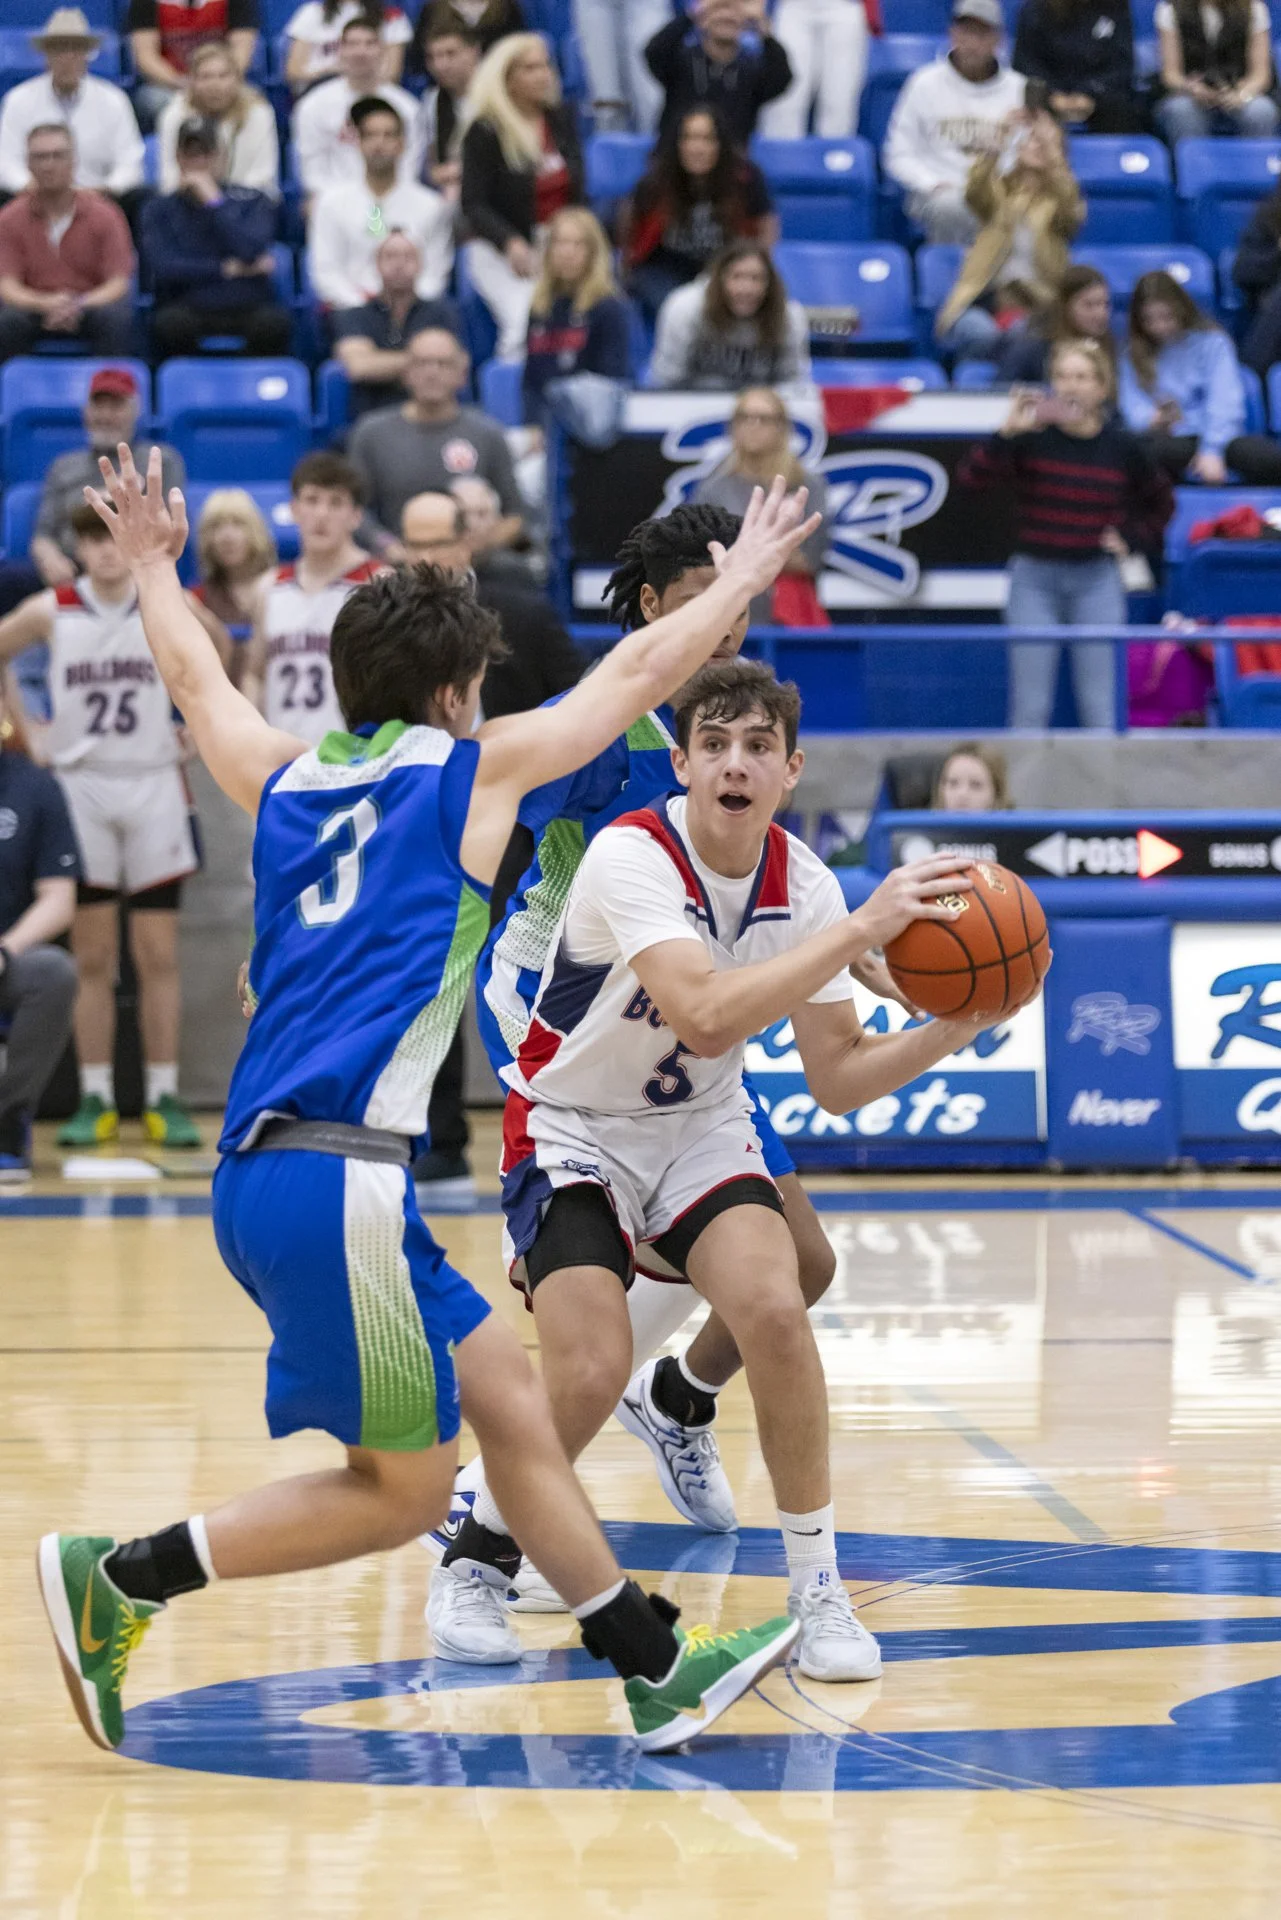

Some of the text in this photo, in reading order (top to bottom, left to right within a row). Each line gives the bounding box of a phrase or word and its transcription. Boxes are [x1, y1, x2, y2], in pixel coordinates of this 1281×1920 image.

[279, 662, 325, 711] 23
[85, 691, 138, 736] 25
[295, 794, 383, 930] 3
[1067, 837, 1140, 875] POSS
[1208, 842, 1269, 868] BONUS
[642, 1040, 702, 1108] 5
[745, 1078, 988, 1136] cets
[1067, 1089, 1161, 1127] Never
